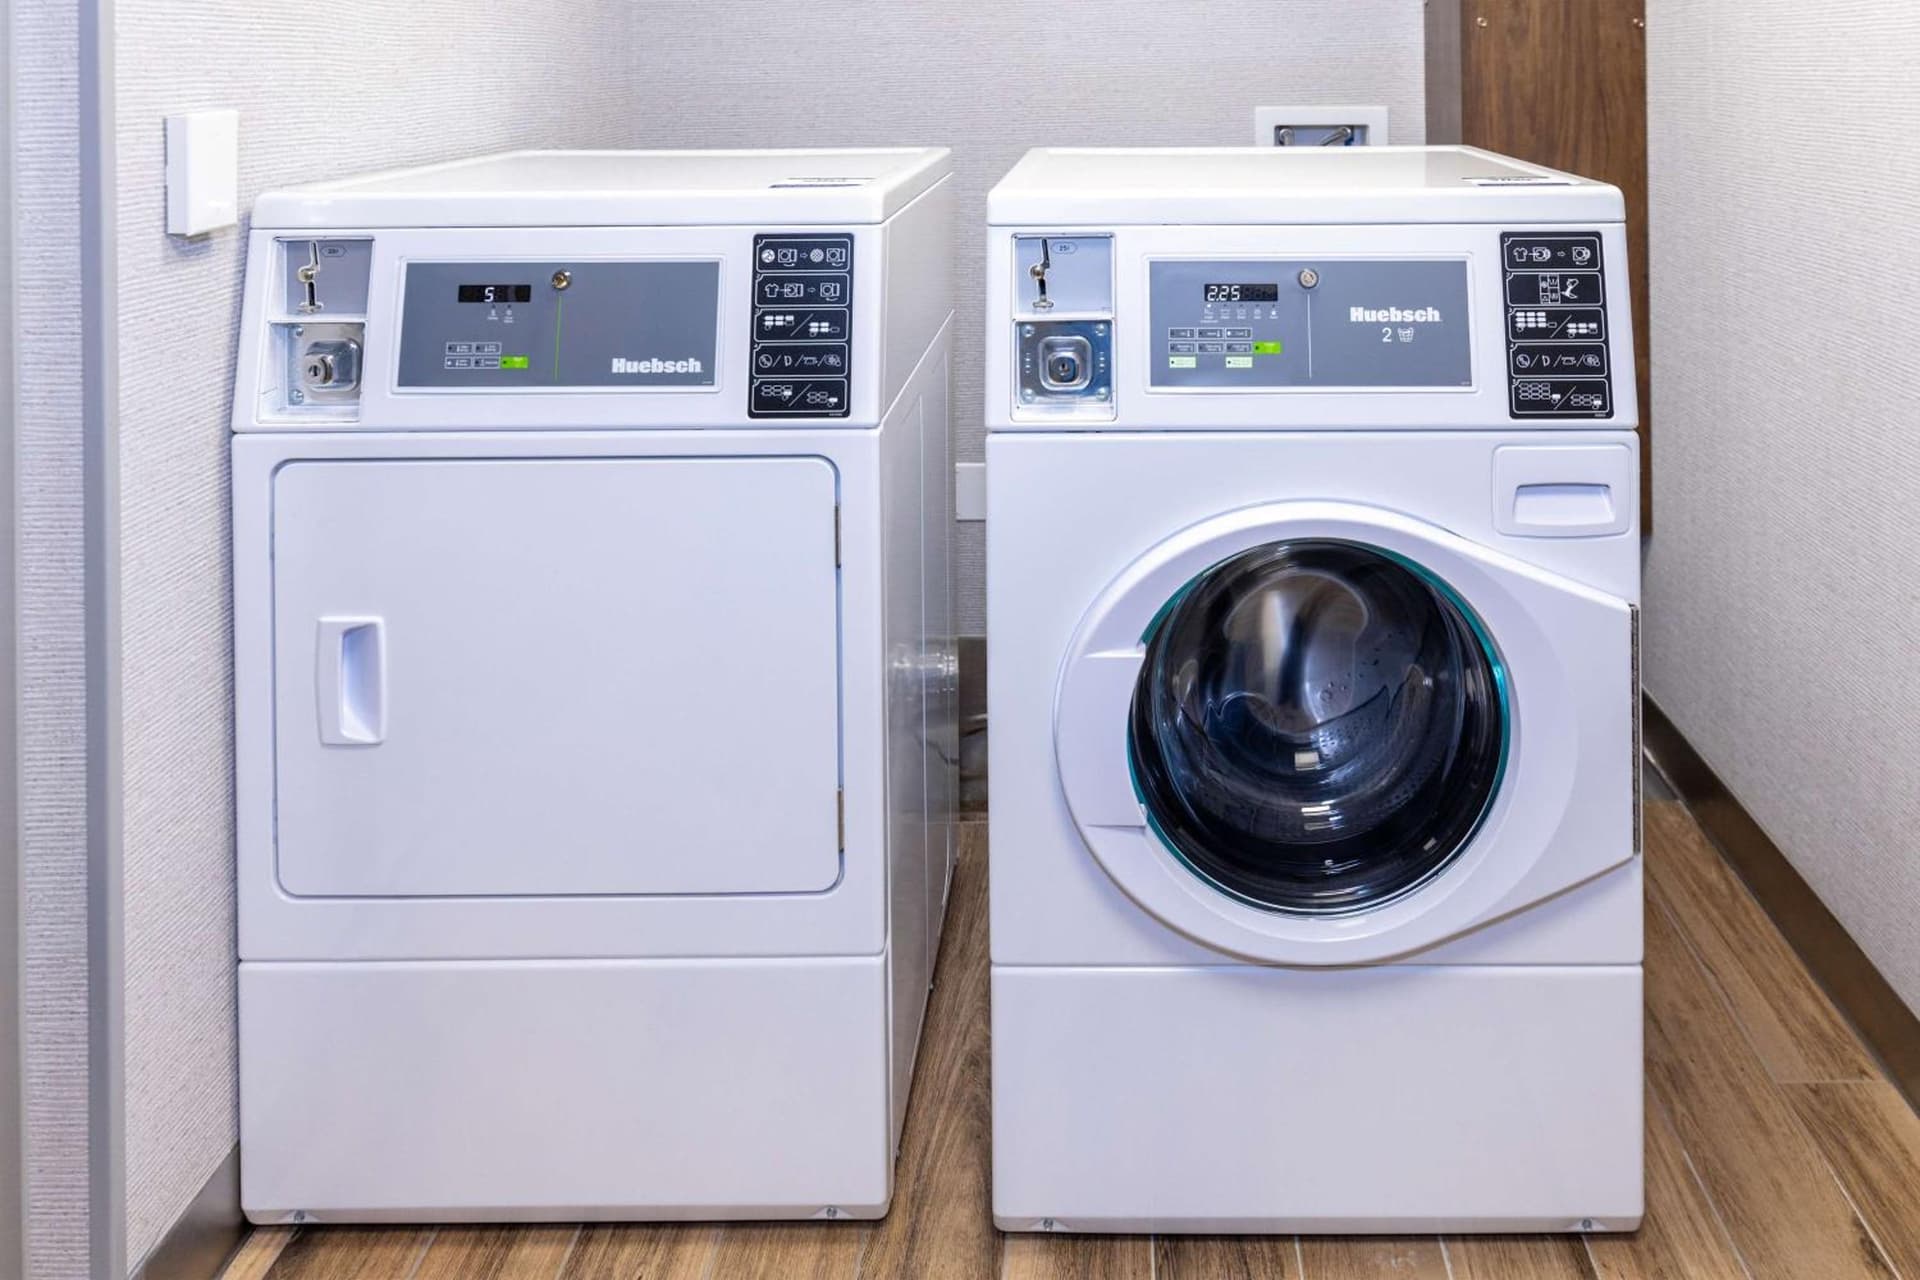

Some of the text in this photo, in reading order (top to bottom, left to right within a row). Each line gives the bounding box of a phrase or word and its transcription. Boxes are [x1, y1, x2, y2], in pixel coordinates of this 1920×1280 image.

[484, 286, 495, 302] 5
[1350, 306, 1441, 322] Huebsch
[1381, 327, 1392, 343] 2
[612, 358, 702, 373] Huebsch
